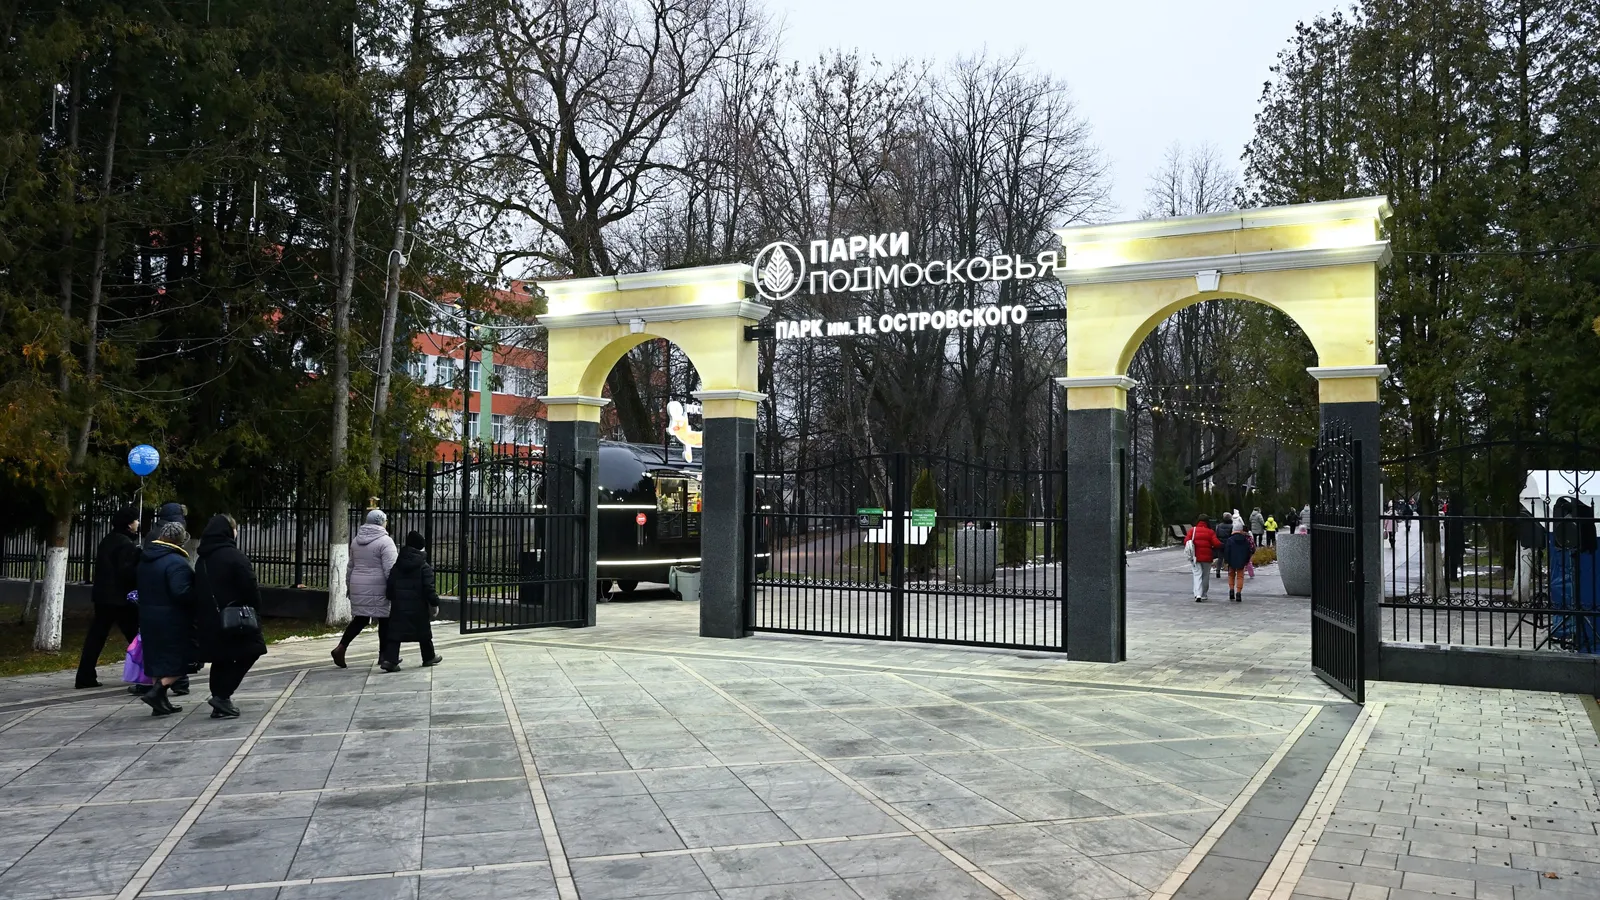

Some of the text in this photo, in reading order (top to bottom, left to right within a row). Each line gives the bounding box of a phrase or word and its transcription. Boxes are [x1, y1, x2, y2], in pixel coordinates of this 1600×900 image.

[810, 231, 909, 264] ПАРКИ
[809, 250, 1058, 294] ПОДМОСКОВЬЯ
[775, 319, 823, 339] ПАРК
[858, 316, 875, 334] Н.
[879, 304, 1028, 333] ОСТРОВСКОГО
